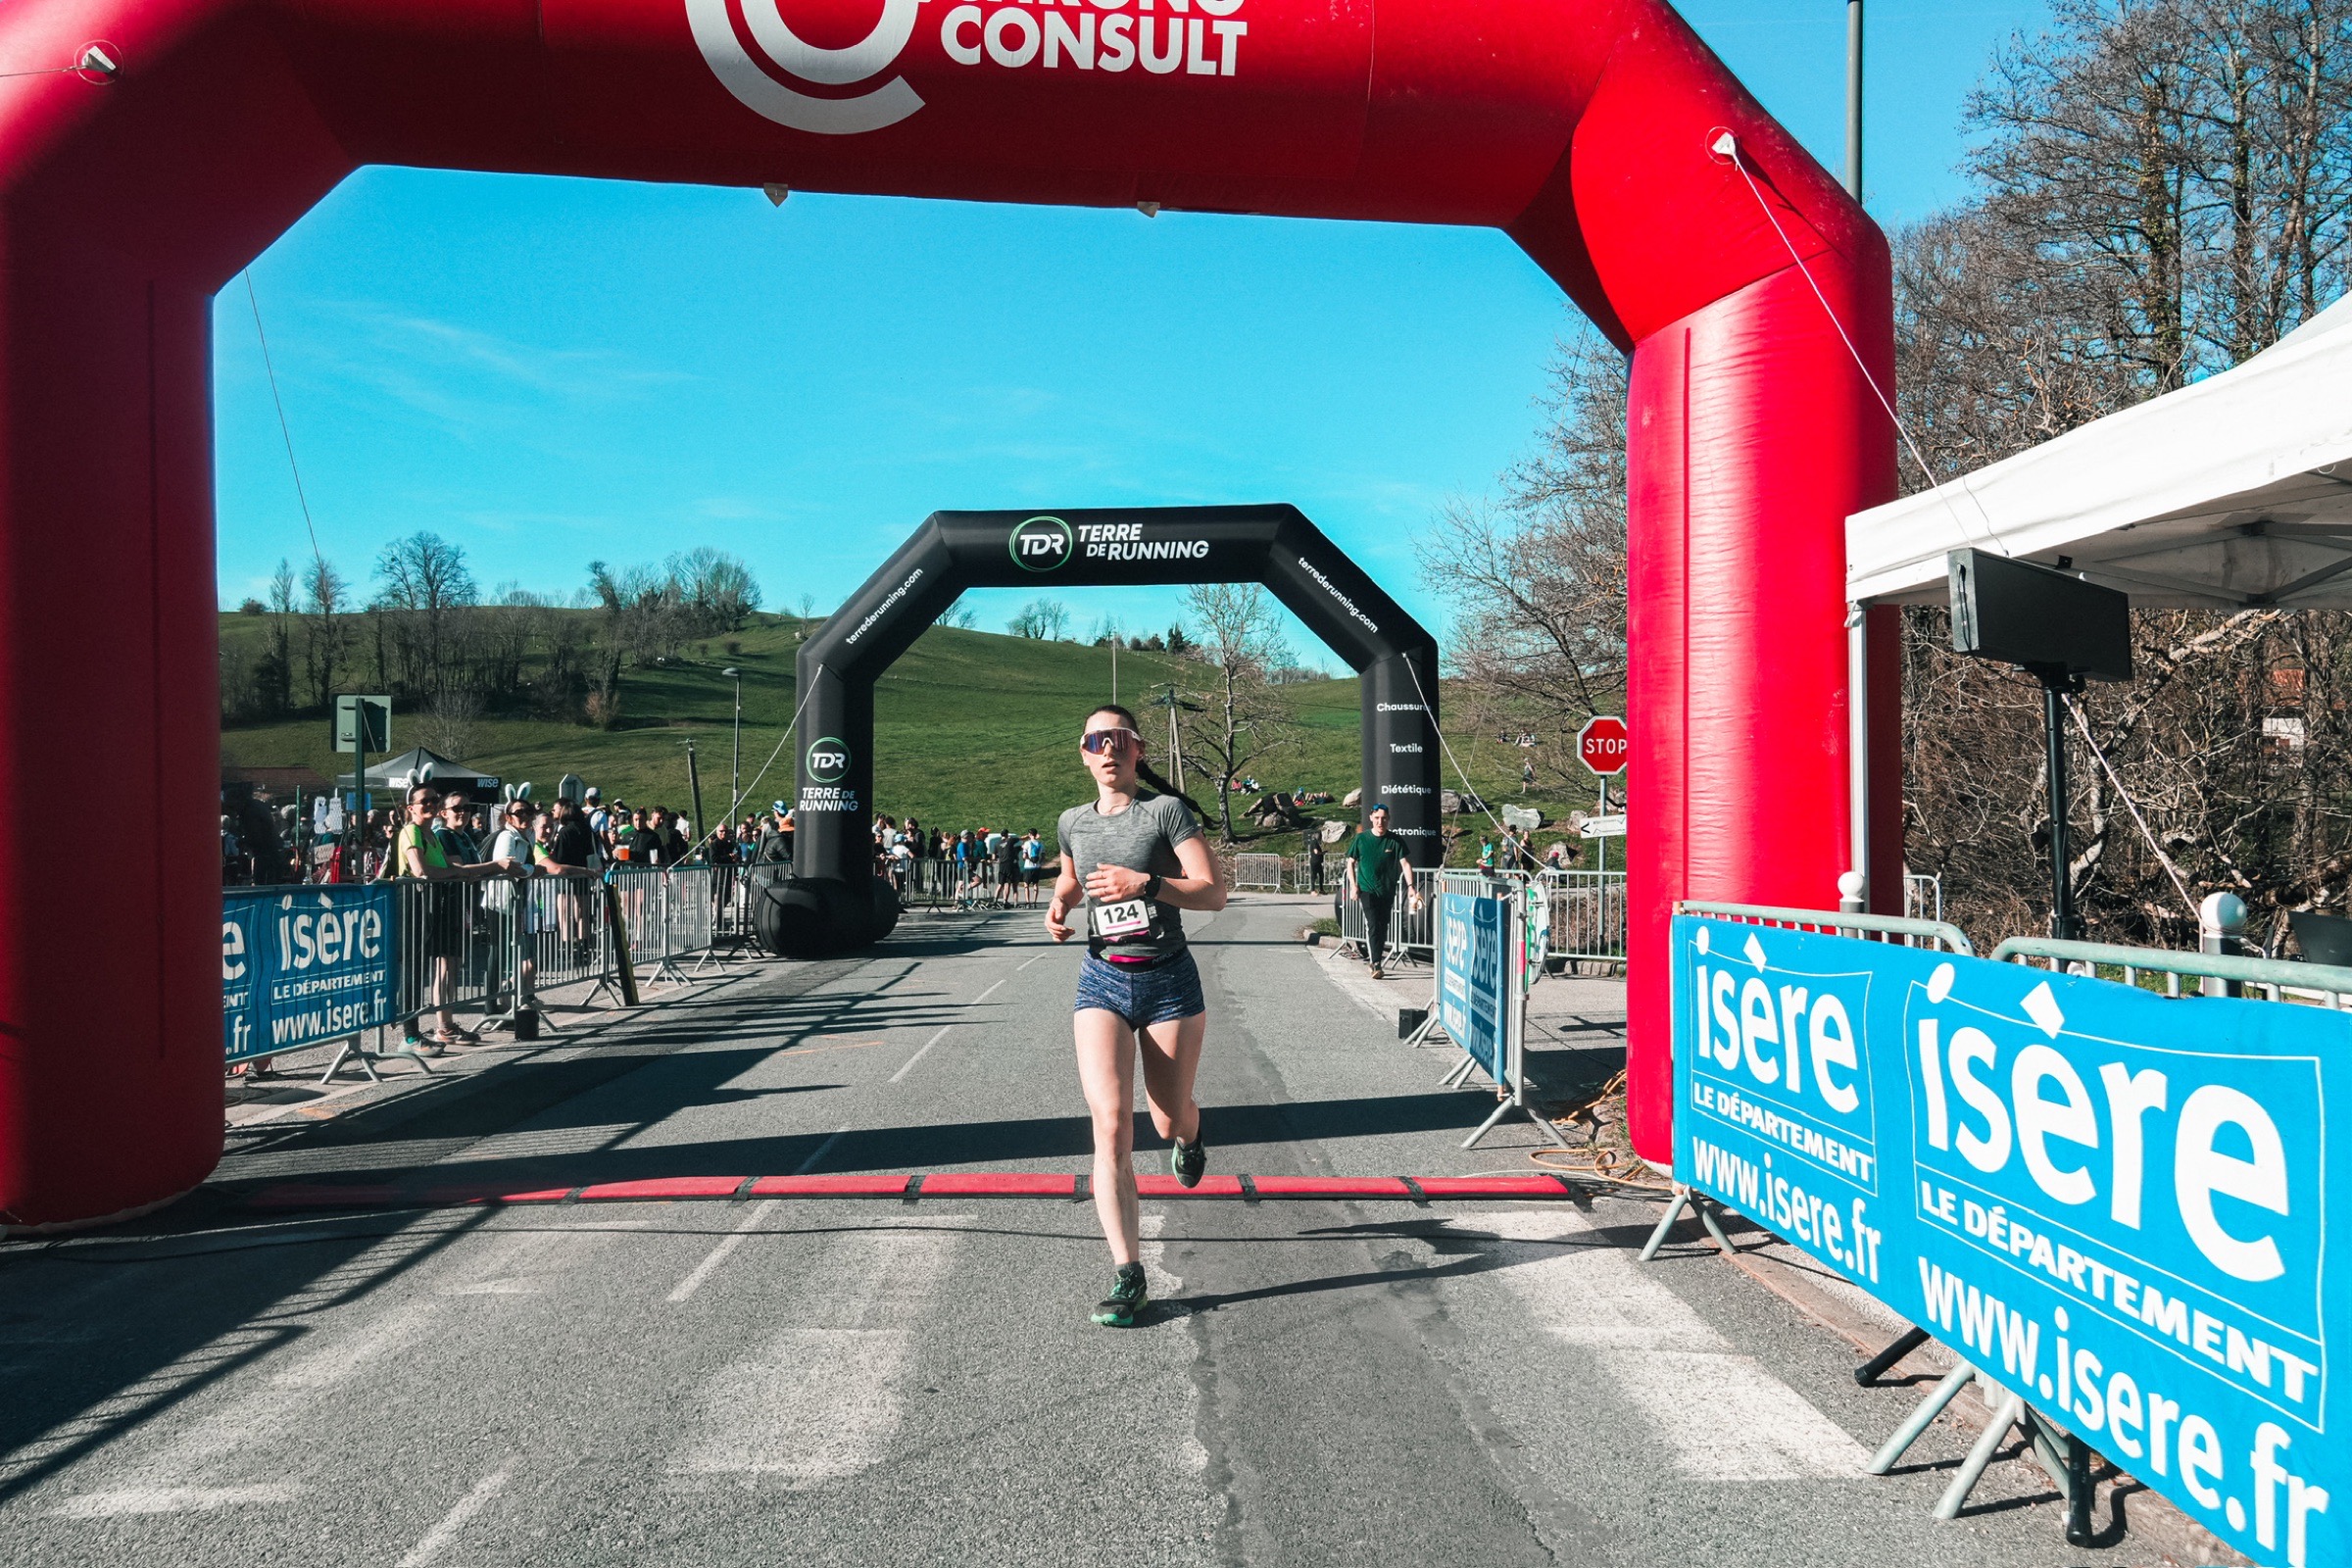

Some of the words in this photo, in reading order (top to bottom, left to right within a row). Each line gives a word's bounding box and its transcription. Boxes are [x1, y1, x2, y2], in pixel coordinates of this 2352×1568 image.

[941, 4, 1248, 76] CONSULT
[1019, 534, 1065, 556] TDR
[1078, 523, 1143, 542] TERRE
[1086, 543, 1107, 558] DE
[1107, 540, 1209, 561] RUNNING
[845, 568, 924, 645] terrederunning.com
[1298, 557, 1378, 634] terrederunning.com
[811, 753, 846, 769] TDR
[1390, 743, 1423, 754] Textile
[1586, 738, 1627, 755] STOP
[477, 777, 499, 788] wise
[803, 787, 841, 800] TERRE
[841, 790, 855, 800] DE
[1381, 784, 1432, 796] Diététique
[799, 800, 858, 811] RUNNING
[1103, 903, 1139, 924] 124
[279, 892, 382, 971] isère
[273, 985, 291, 1001] LE
[293, 969, 386, 997] DÉPARTEMENT
[271, 989, 387, 1045] www.isere.fr
[1696, 925, 1860, 1114] isère
[1694, 1082, 1715, 1110] LE
[1717, 1091, 1874, 1183] DÉPARTEMENT
[1918, 961, 2290, 1282] isère
[1692, 1136, 1882, 1285] www.isere.fr
[1921, 1180, 1957, 1225] LE
[1964, 1204, 2320, 1403] DÉPARTEMENT
[1918, 1255, 2329, 1568] www.isere.fr
